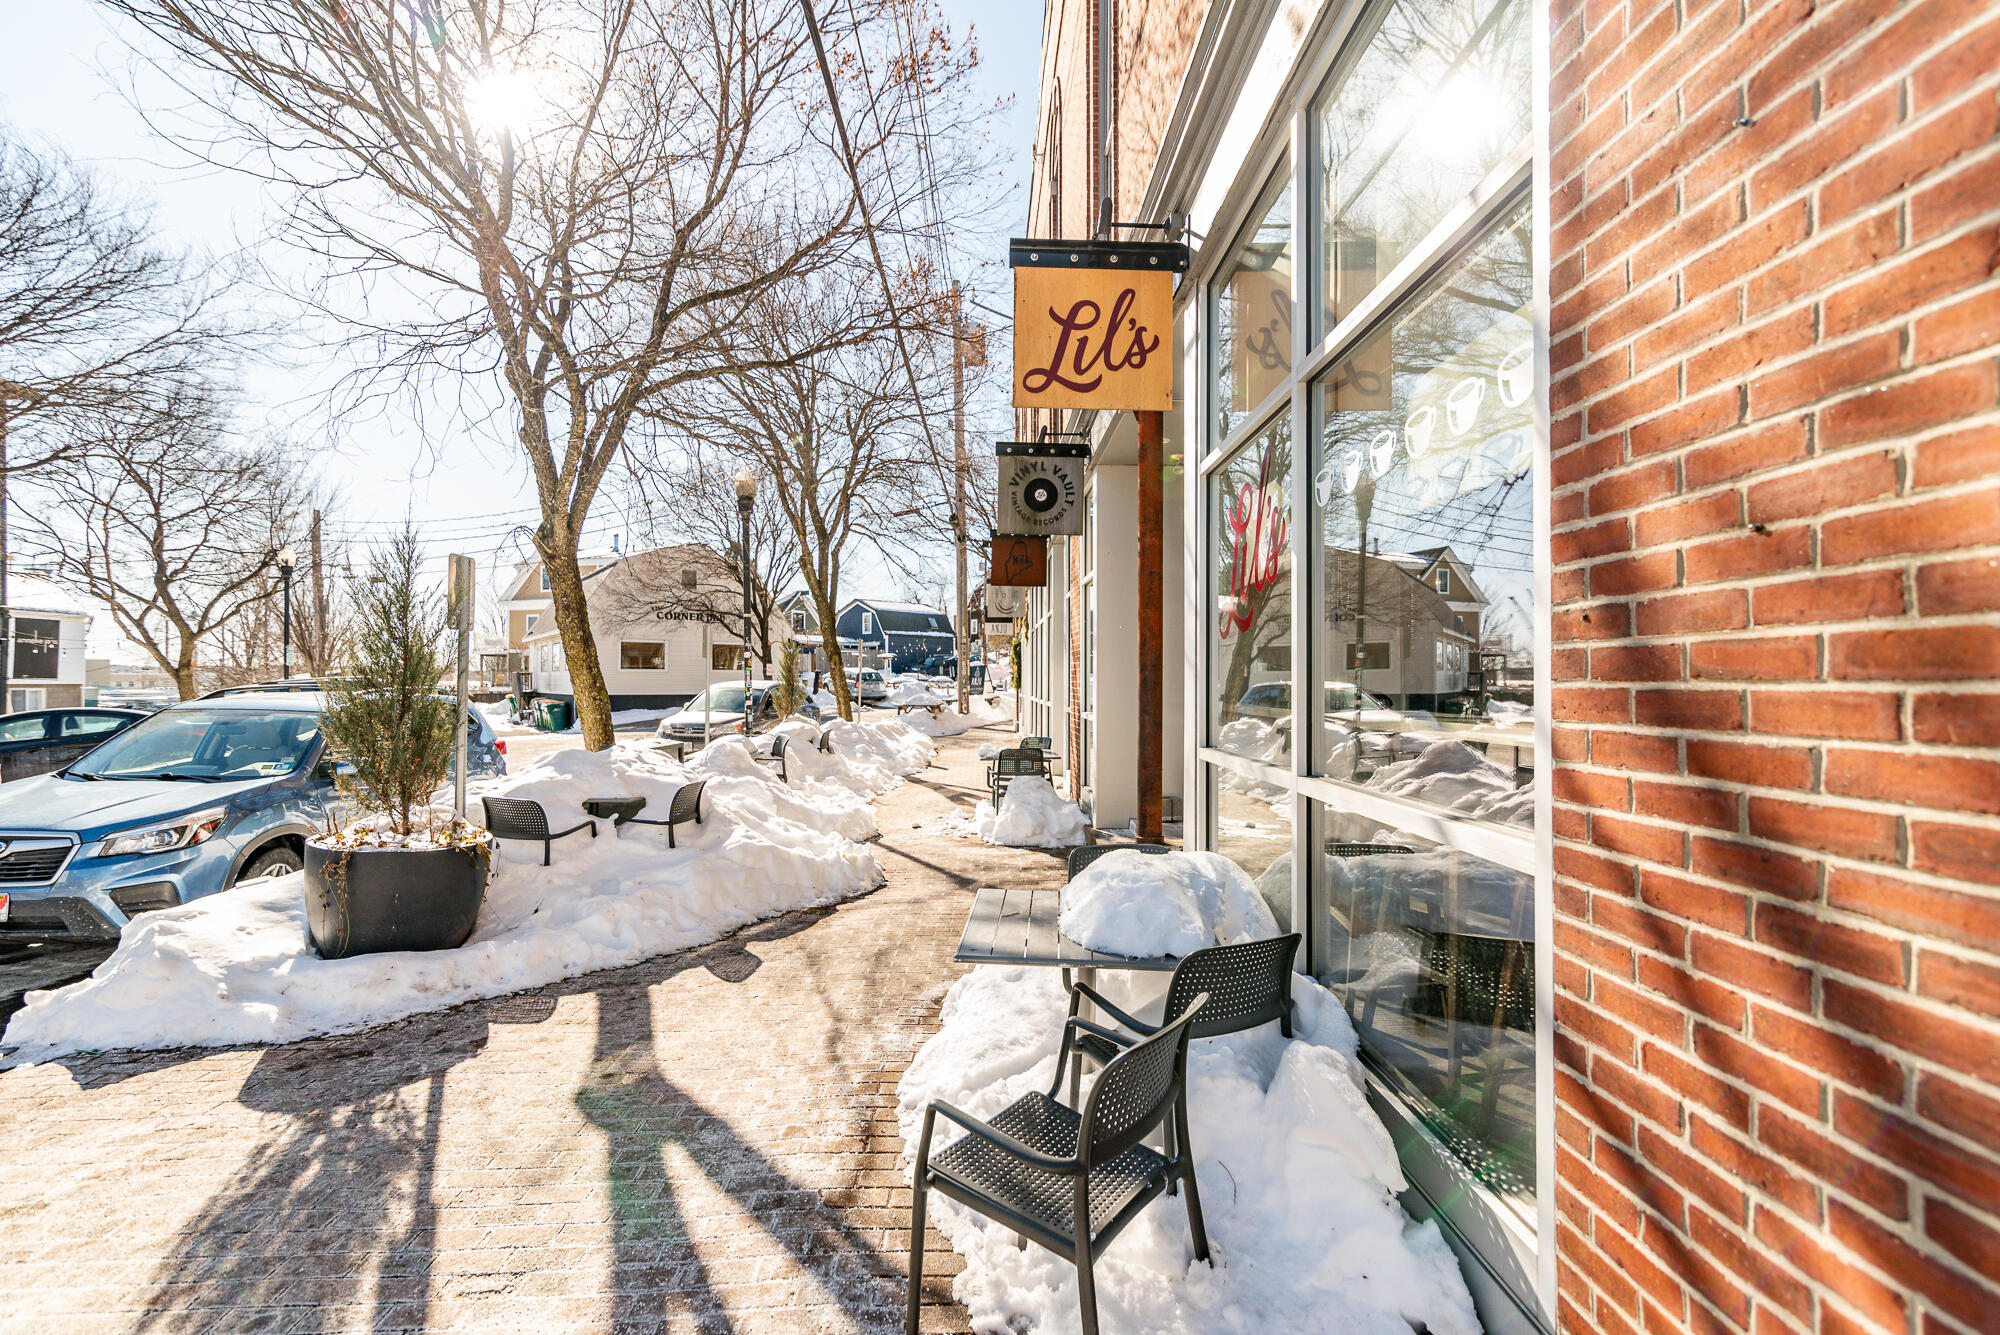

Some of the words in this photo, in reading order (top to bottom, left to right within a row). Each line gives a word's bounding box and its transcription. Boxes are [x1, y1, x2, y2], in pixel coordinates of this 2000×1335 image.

[1022, 288, 1160, 393] Lil's
[1009, 461, 1047, 487] VINYL
[1053, 464, 1075, 506] VAULT
[1011, 491, 1032, 522] VINTAGE
[1033, 507, 1067, 526] RECORDS
[1219, 444, 1286, 640] Lil's
[656, 611, 703, 621] CORNER
